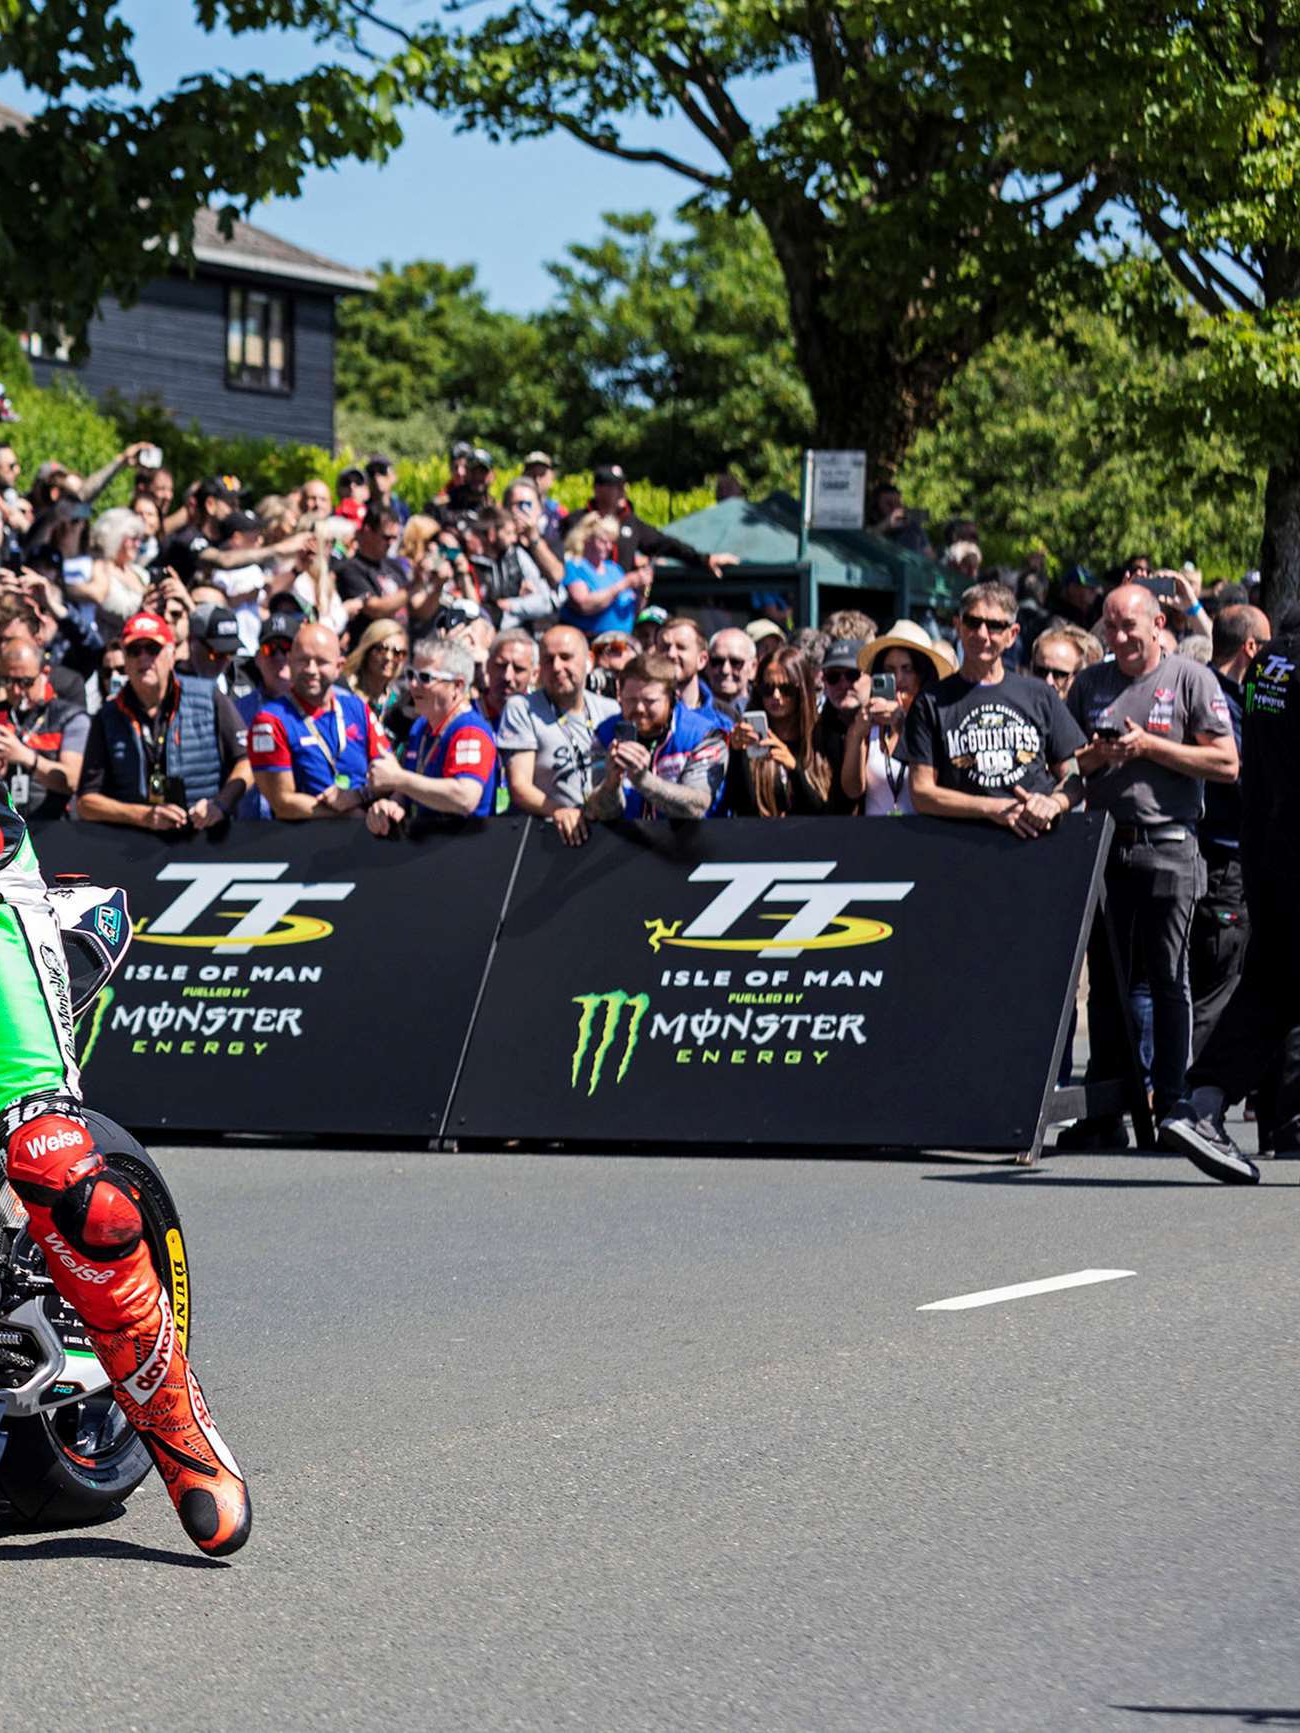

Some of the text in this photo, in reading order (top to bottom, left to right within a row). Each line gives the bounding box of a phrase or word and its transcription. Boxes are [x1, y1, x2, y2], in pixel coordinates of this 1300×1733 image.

[146, 862, 356, 954] TT
[681, 861, 915, 958] TT
[124, 965, 322, 982] ISLE OF MAN
[661, 970, 883, 987] ISLE OF MAN
[182, 986, 250, 998] FUELLED BY
[728, 992, 804, 1004] FUELLED BY
[132, 1040, 268, 1055] ENERGY
[676, 1049, 829, 1064] ENERGY
[26, 1129, 84, 1159] Weise
[44, 1232, 116, 1285] Weise
[135, 1301, 173, 1392] daytona
